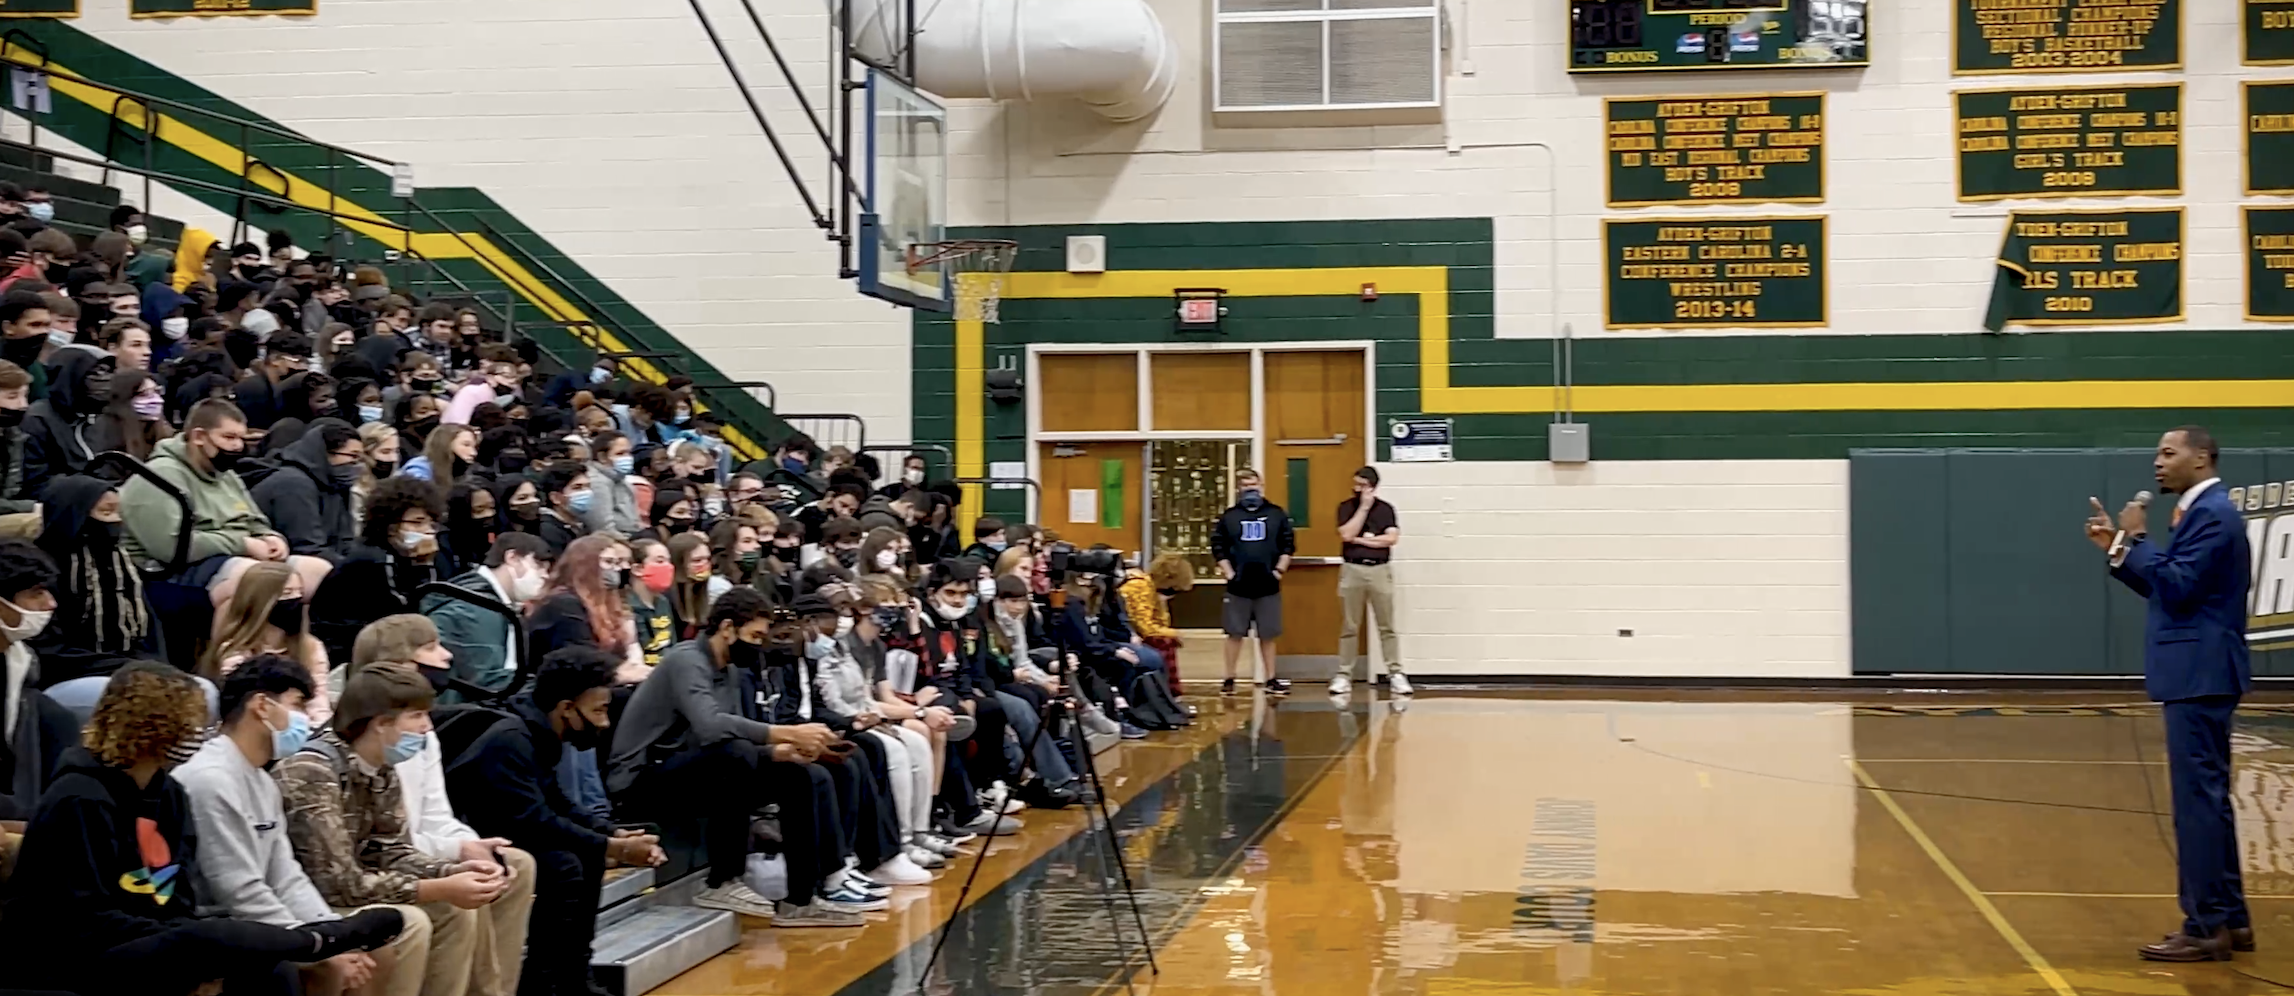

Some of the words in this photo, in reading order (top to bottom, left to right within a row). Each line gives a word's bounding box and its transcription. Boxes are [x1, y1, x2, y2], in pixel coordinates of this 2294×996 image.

[1690, 13, 1747, 25] PERIOD
[1976, 9, 2062, 24] SECTIONAL
[2071, 6, 2160, 21] CHAMPIONS
[1982, 24, 2059, 39] REGIONAL
[2067, 21, 2153, 36] RUNNER-UP
[2044, 36, 2145, 51] BASKETBALL
[1605, 51, 1658, 63] BONUS
[2011, 51, 2123, 67] 2003-2004
[2072, 152, 2124, 167] TRACK
[1716, 165, 1765, 180] TRACK
[1656, 226, 1772, 241] AYDEN-GRIFTON
[2014, 221, 2129, 237] YDEN-GRIFTON
[1622, 246, 1690, 260] EASTERN
[1698, 244, 1772, 259] CAROLINA
[1780, 244, 1808, 258] 2-A
[1621, 264, 1717, 278] CONFERENCE
[1725, 263, 1810, 277] CHAMPIONS
[2069, 270, 2139, 289] TRACK
[1669, 281, 1762, 296] WRESTLING
[1675, 301, 1756, 318] 2013-14
[2044, 297, 2093, 312] 2010
